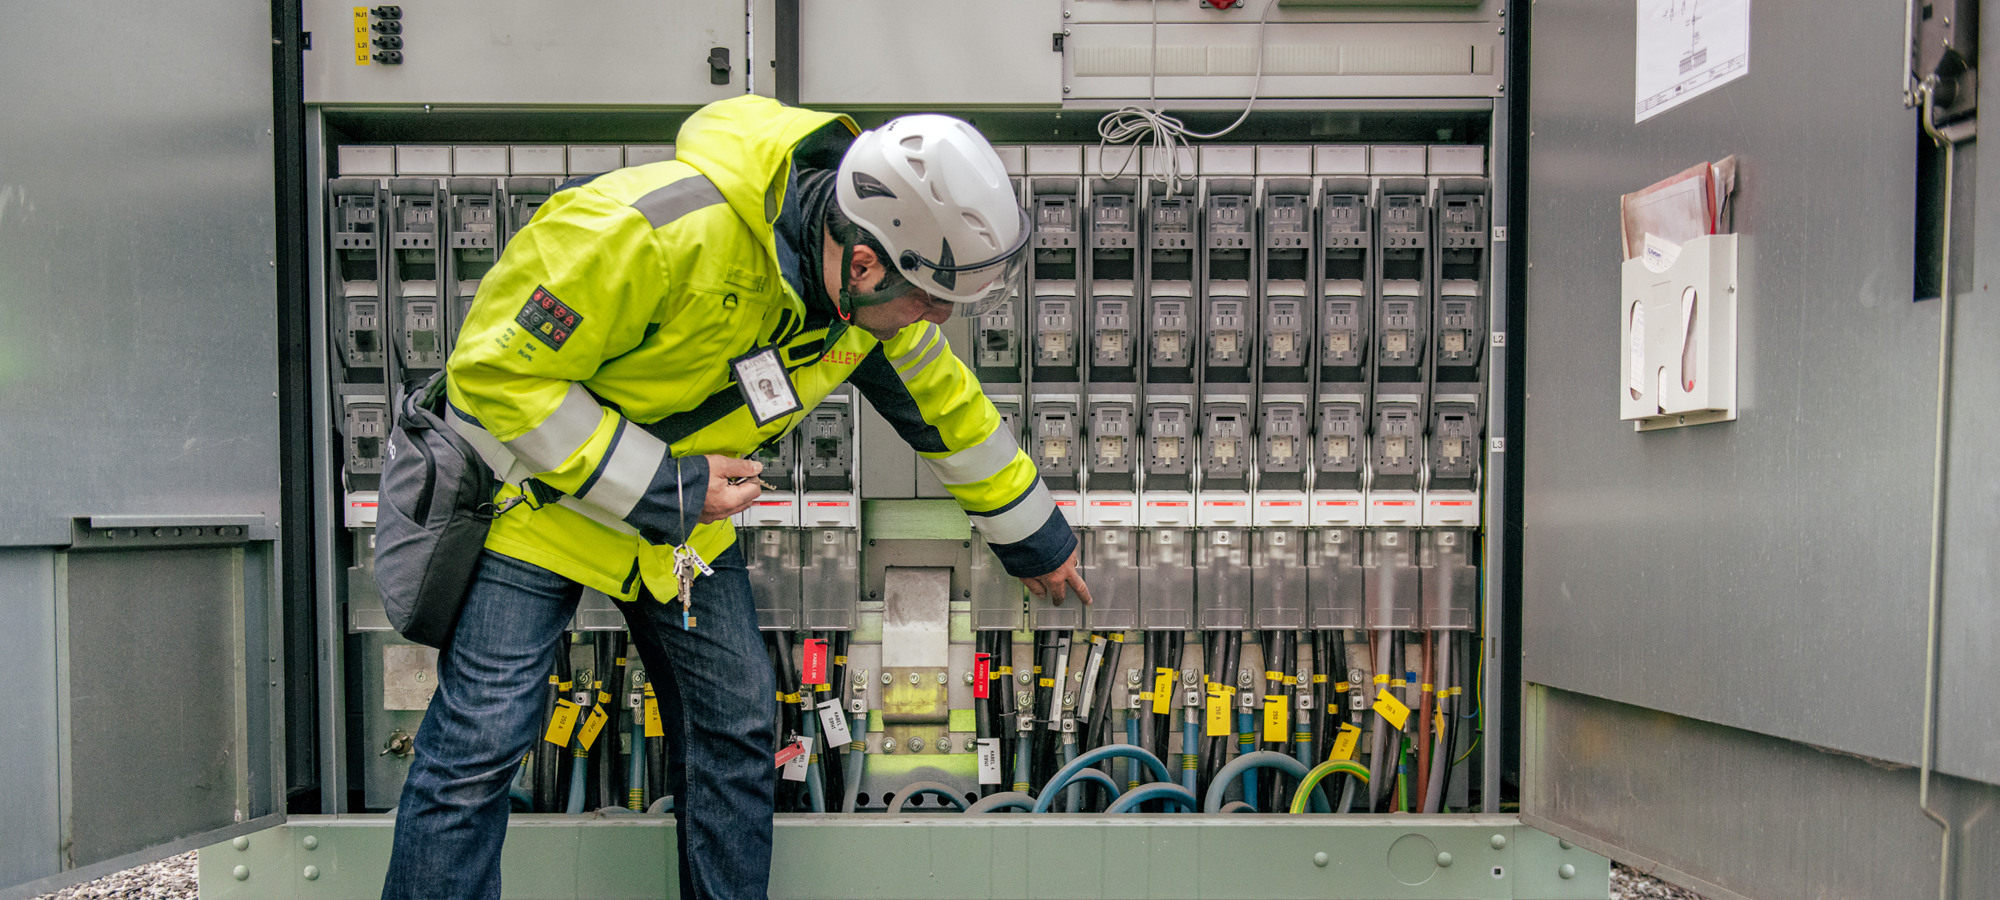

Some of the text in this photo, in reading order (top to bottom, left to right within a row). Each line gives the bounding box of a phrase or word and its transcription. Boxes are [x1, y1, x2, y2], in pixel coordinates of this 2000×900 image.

[1494, 229, 1505, 238] L1
[1493, 335, 1504, 344] L2
[1492, 440, 1503, 449] L3
[834, 711, 842, 727] KABEL
